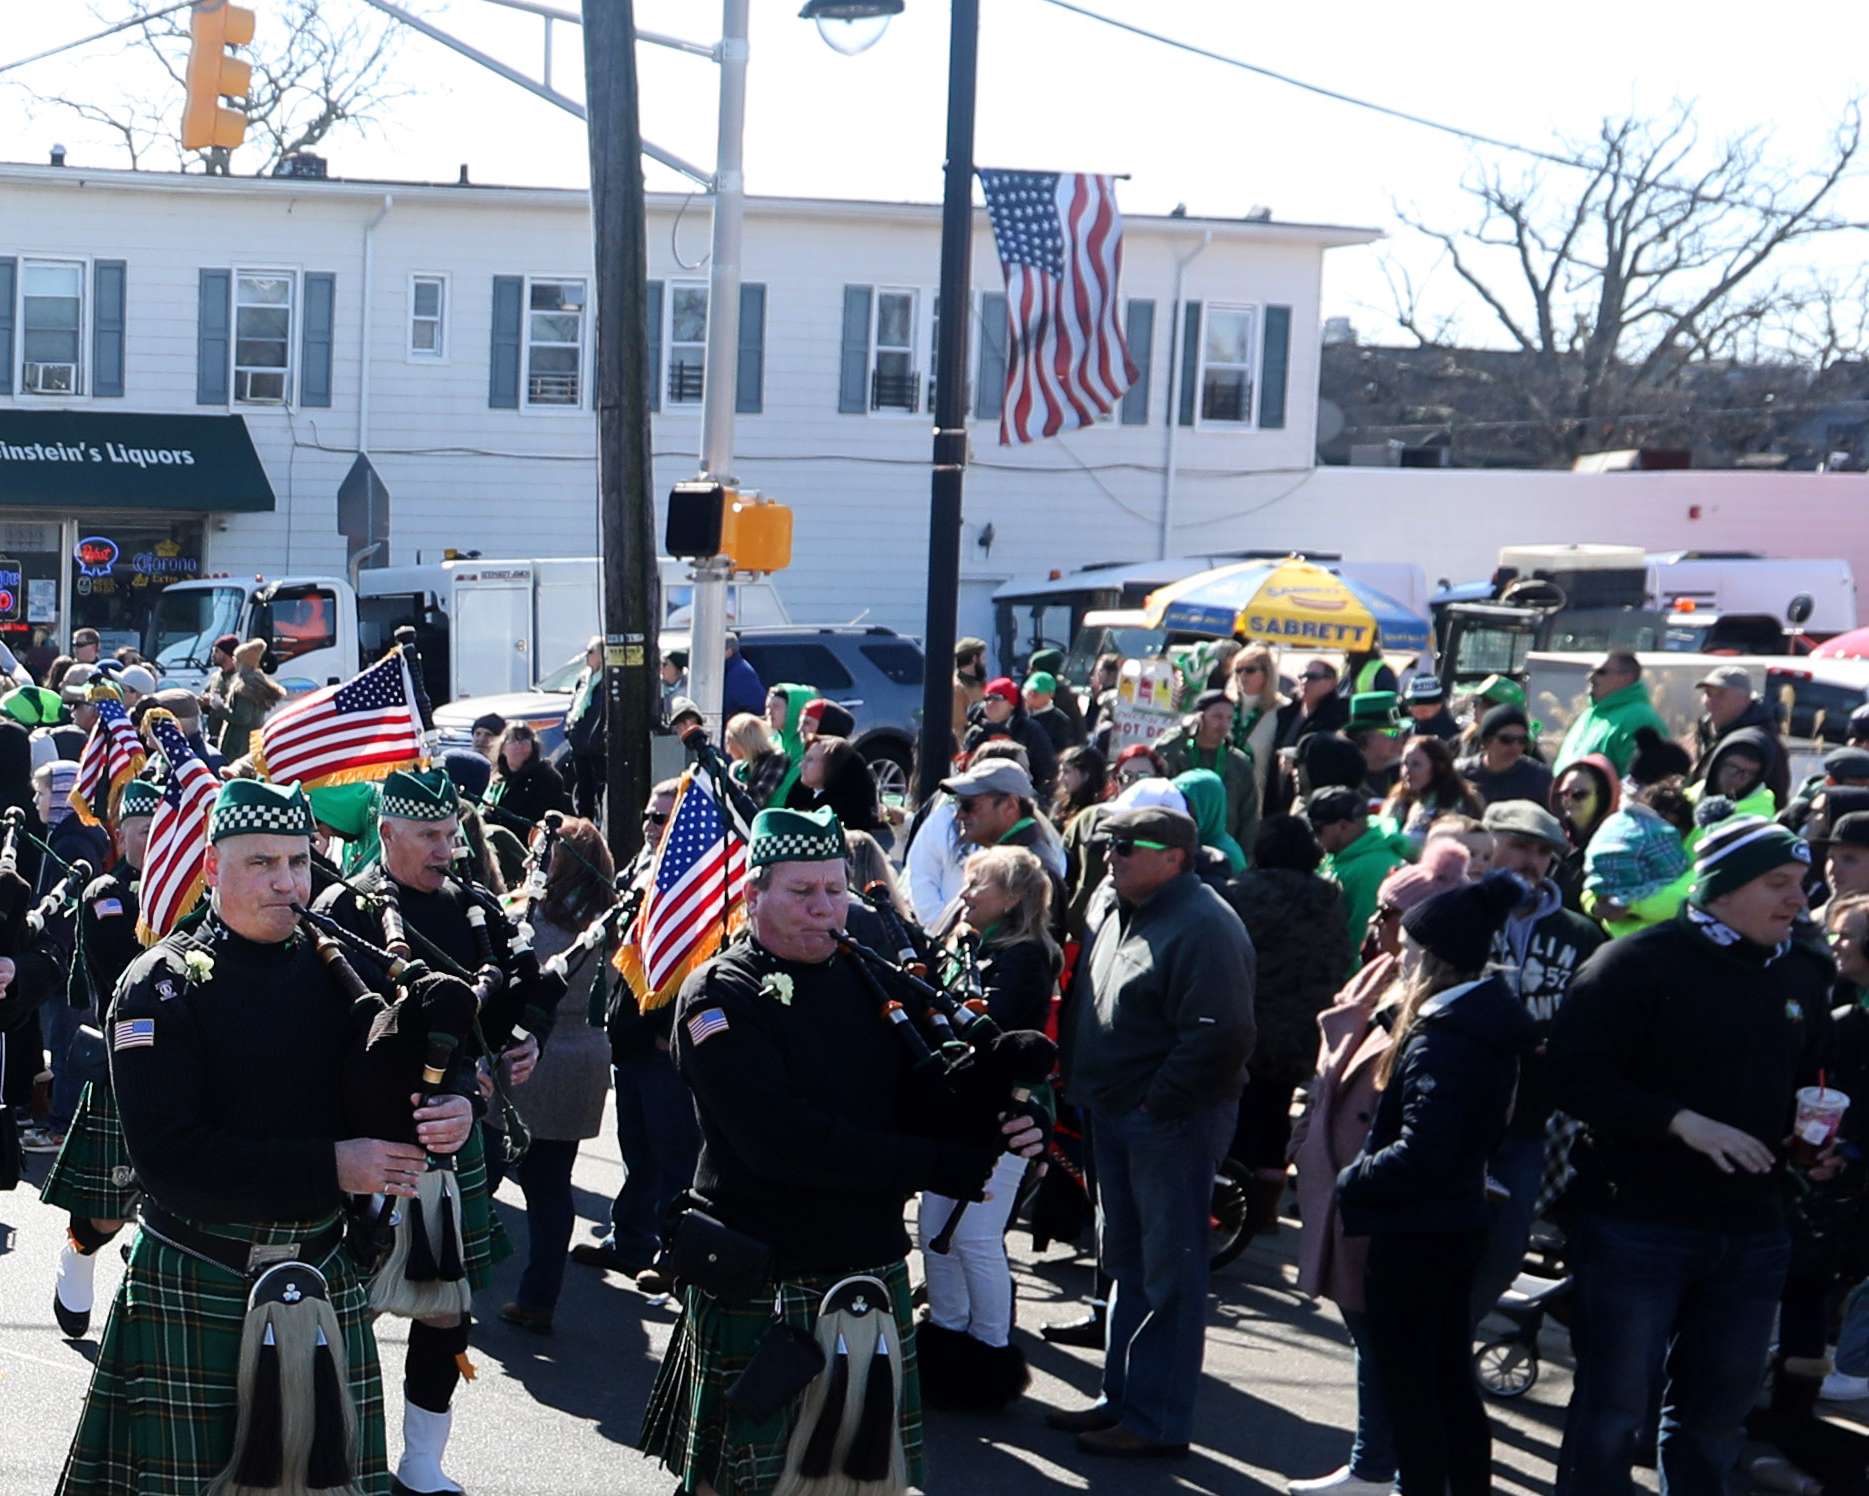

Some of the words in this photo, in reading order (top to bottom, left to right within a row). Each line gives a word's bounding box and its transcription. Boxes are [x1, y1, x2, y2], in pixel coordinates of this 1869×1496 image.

[105, 442, 195, 469] Liquors
[132, 552, 198, 574] Corona
[1250, 616, 1368, 642] SABRETT
[1112, 722, 1141, 735] HOT
